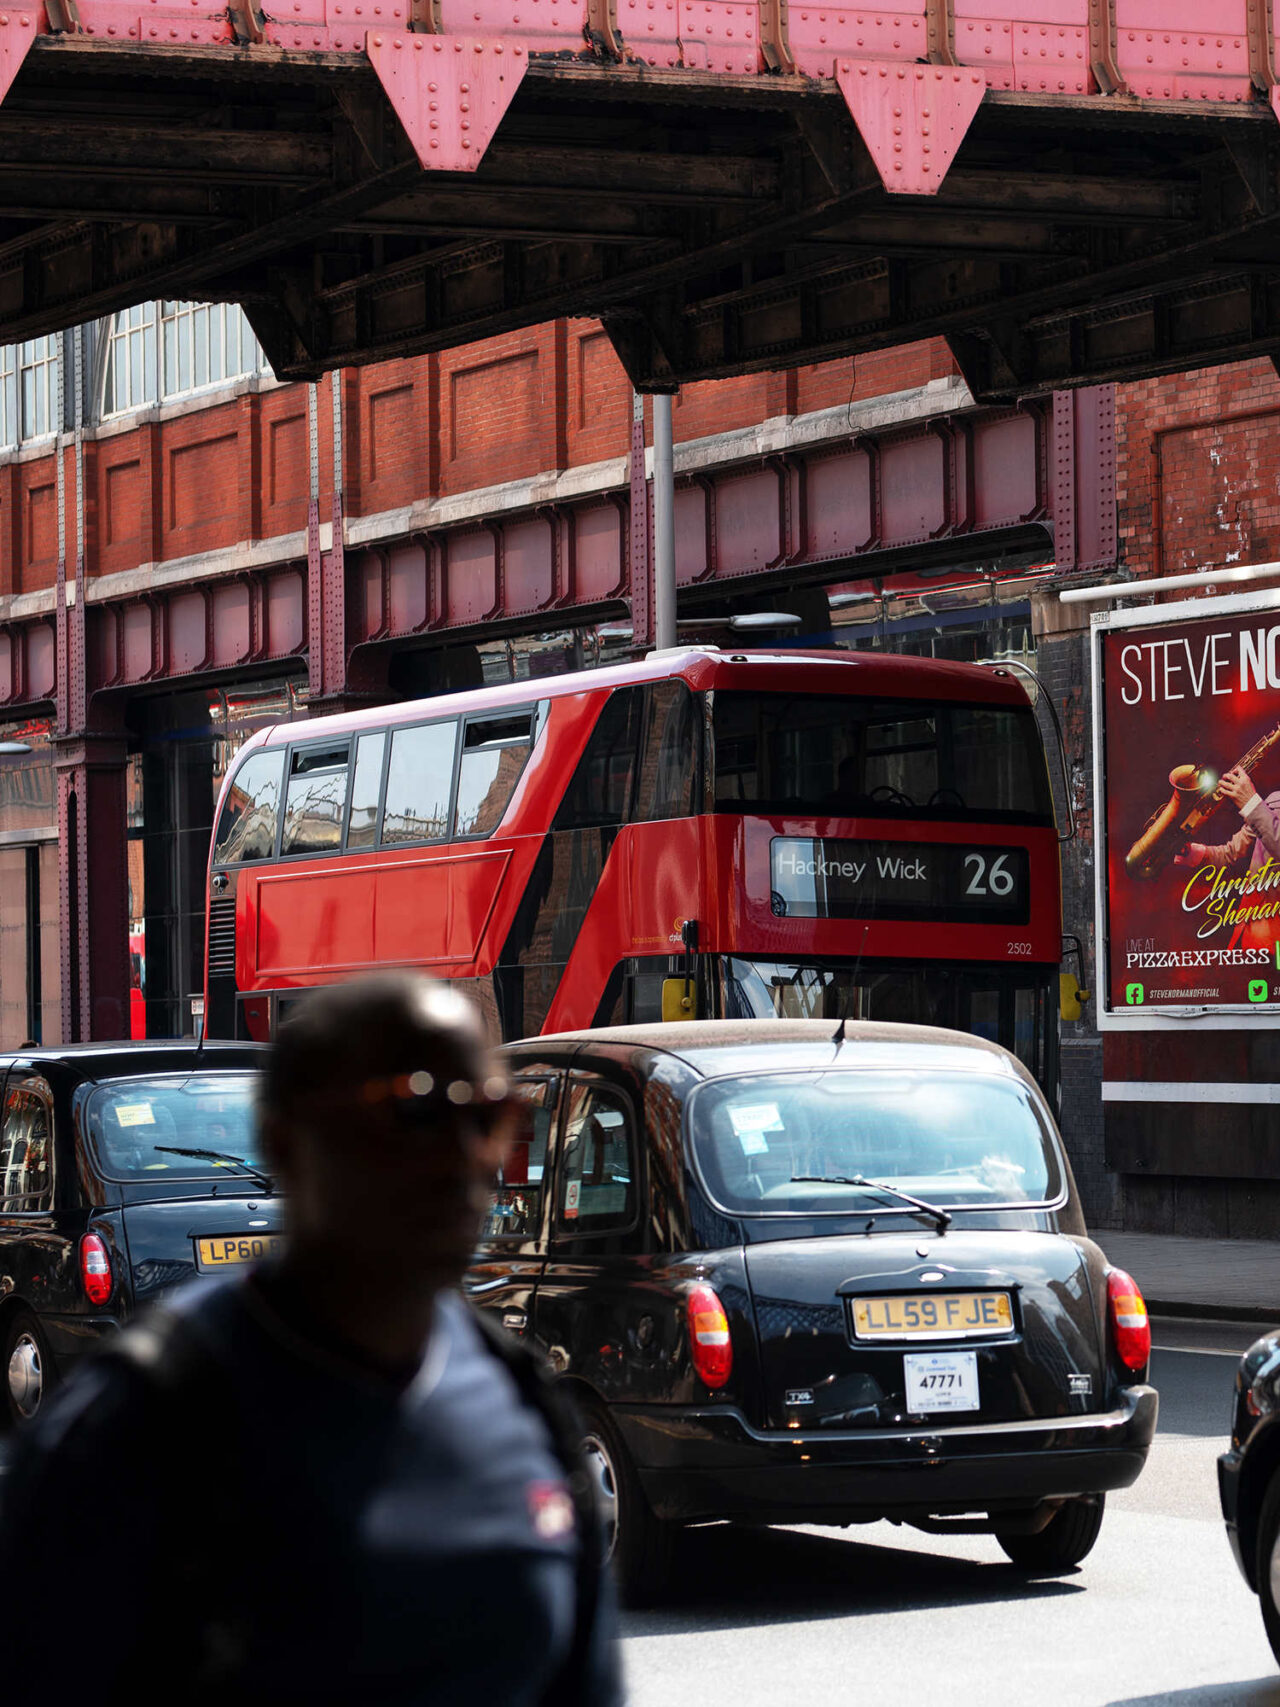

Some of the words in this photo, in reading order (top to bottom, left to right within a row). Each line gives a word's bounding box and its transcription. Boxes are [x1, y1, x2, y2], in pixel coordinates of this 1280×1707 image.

[1120, 632, 1233, 705] STEVE
[778, 853, 866, 883] Hackney
[876, 856, 927, 880] Wick
[964, 853, 1014, 896] 26
[1007, 942, 1032, 955] 2502
[1126, 938, 1143, 951] LIVE
[1144, 938, 1156, 951] AT
[1149, 988, 1220, 999] STEVENORMANOFFICIAL
[210, 1240, 264, 1260] LP60
[866, 1300, 938, 1329] LL59
[920, 1374, 962, 1389] 47771
